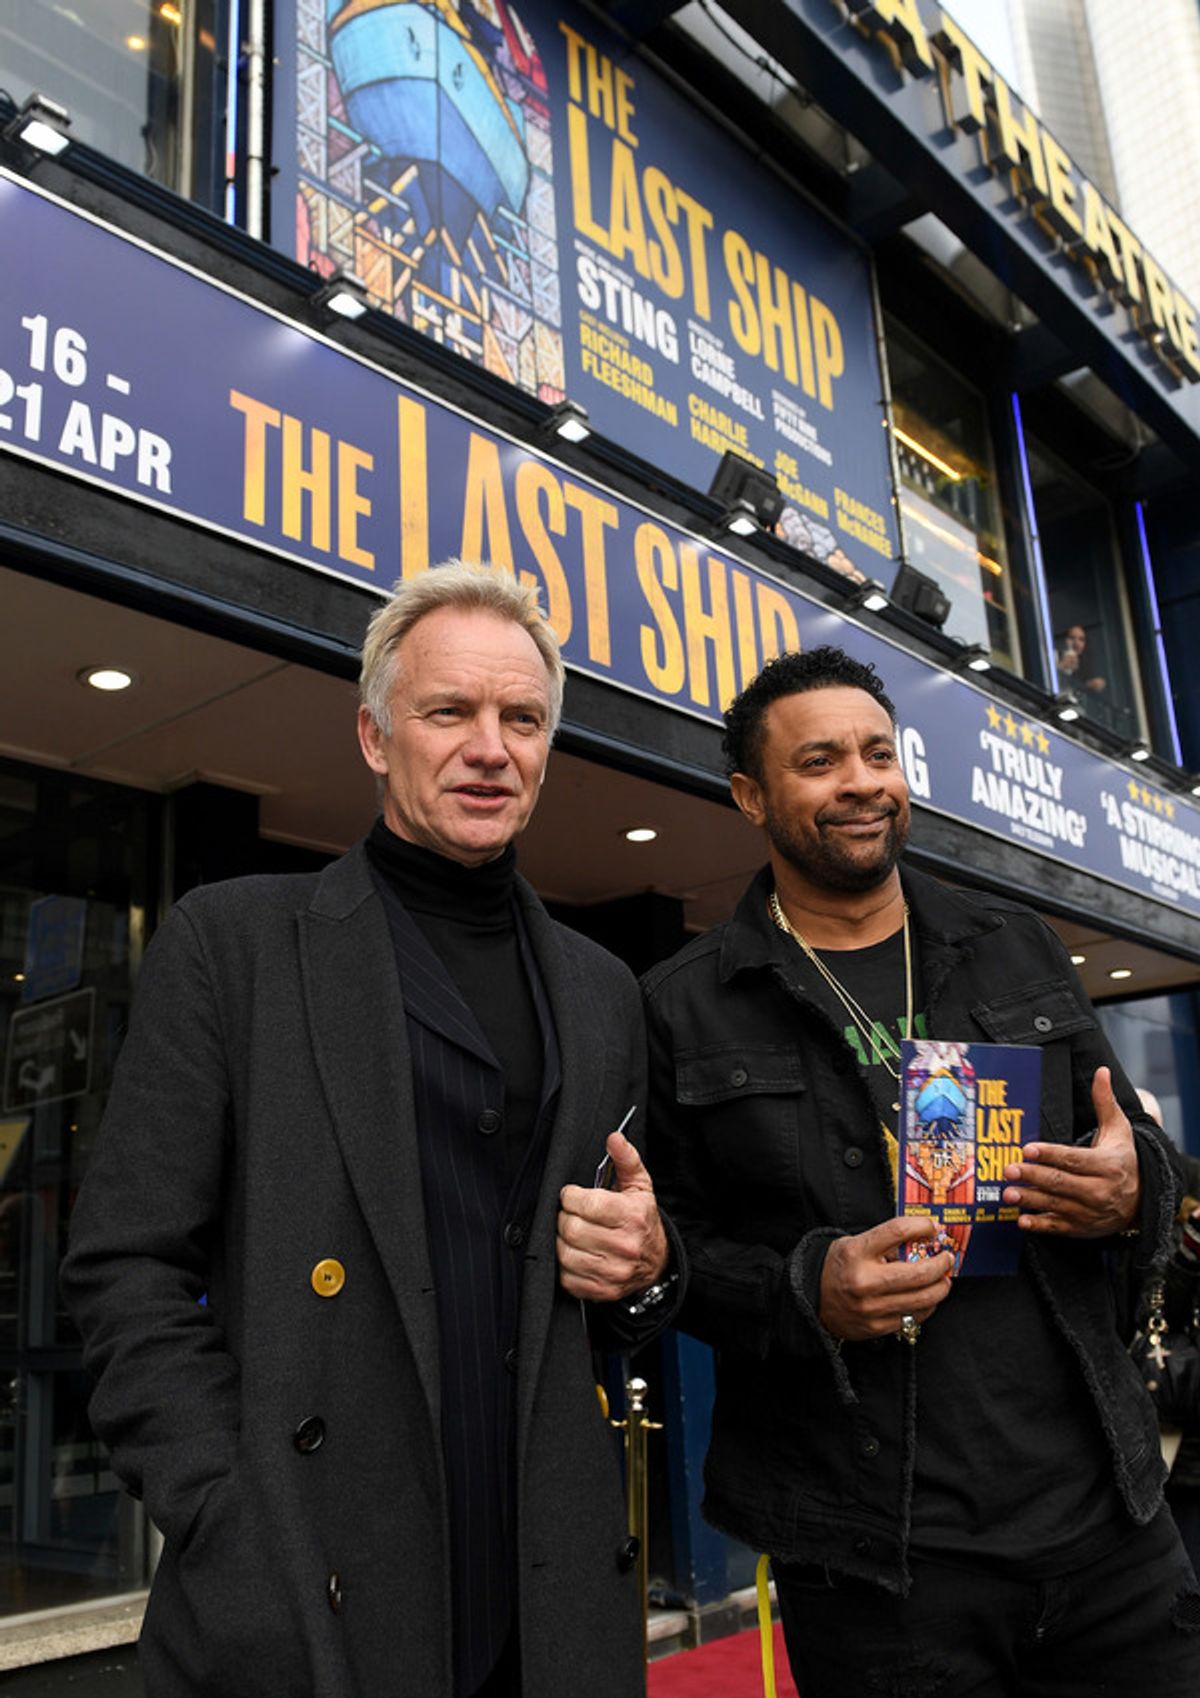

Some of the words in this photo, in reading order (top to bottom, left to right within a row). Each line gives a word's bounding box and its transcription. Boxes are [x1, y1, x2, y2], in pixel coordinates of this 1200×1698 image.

[559, 20, 639, 148] THE
[941, 11, 1200, 378] THEATRE
[567, 102, 713, 322] LAST
[723, 230, 845, 411] SHIP
[577, 255, 679, 365] STING
[22, 314, 88, 387] 16
[580, 322, 654, 388] RICHARD
[581, 348, 678, 427] FLEESHMAN
[691, 355, 765, 421] CAMPBELL
[58, 400, 172, 494] APR
[688, 393, 749, 448] CHARLIE
[230, 388, 375, 571] THE
[398, 394, 619, 667] LAST
[976, 1079, 1008, 1107] THE
[976, 1108, 1025, 1143] LAST
